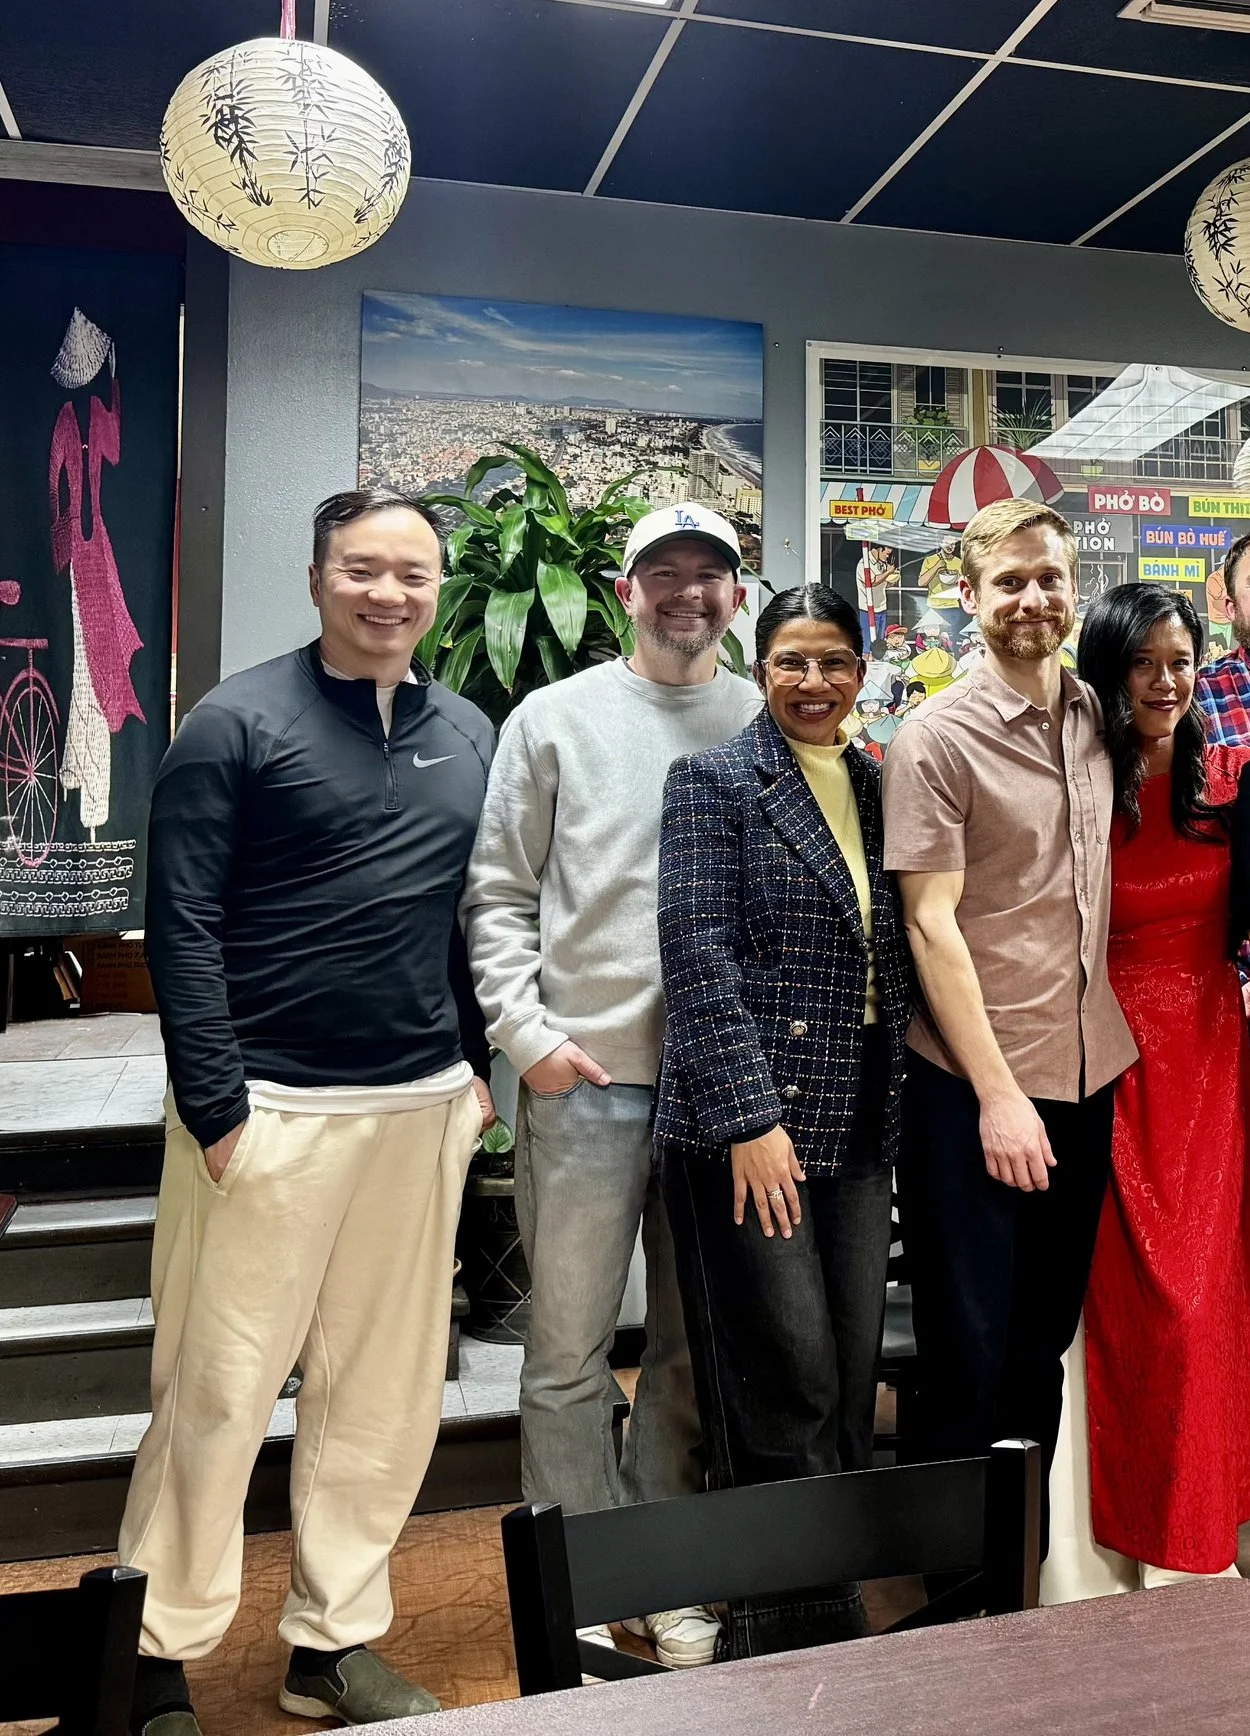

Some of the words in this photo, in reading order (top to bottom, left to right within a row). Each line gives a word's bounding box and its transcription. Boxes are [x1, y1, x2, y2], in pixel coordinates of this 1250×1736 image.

[1094, 490, 1136, 511] PHỞ
[1138, 492, 1165, 512] BÒ
[1193, 498, 1221, 513] BÚN
[675, 510, 700, 529] LA
[834, 505, 860, 516] BEST
[1073, 517, 1111, 535] PHỞ
[1146, 526, 1174, 544] BÚN
[1178, 527, 1196, 545] BÒ
[1200, 530, 1227, 546] HUẾ
[1143, 560, 1180, 577] BÁNH
[1184, 561, 1200, 578] MÌ
